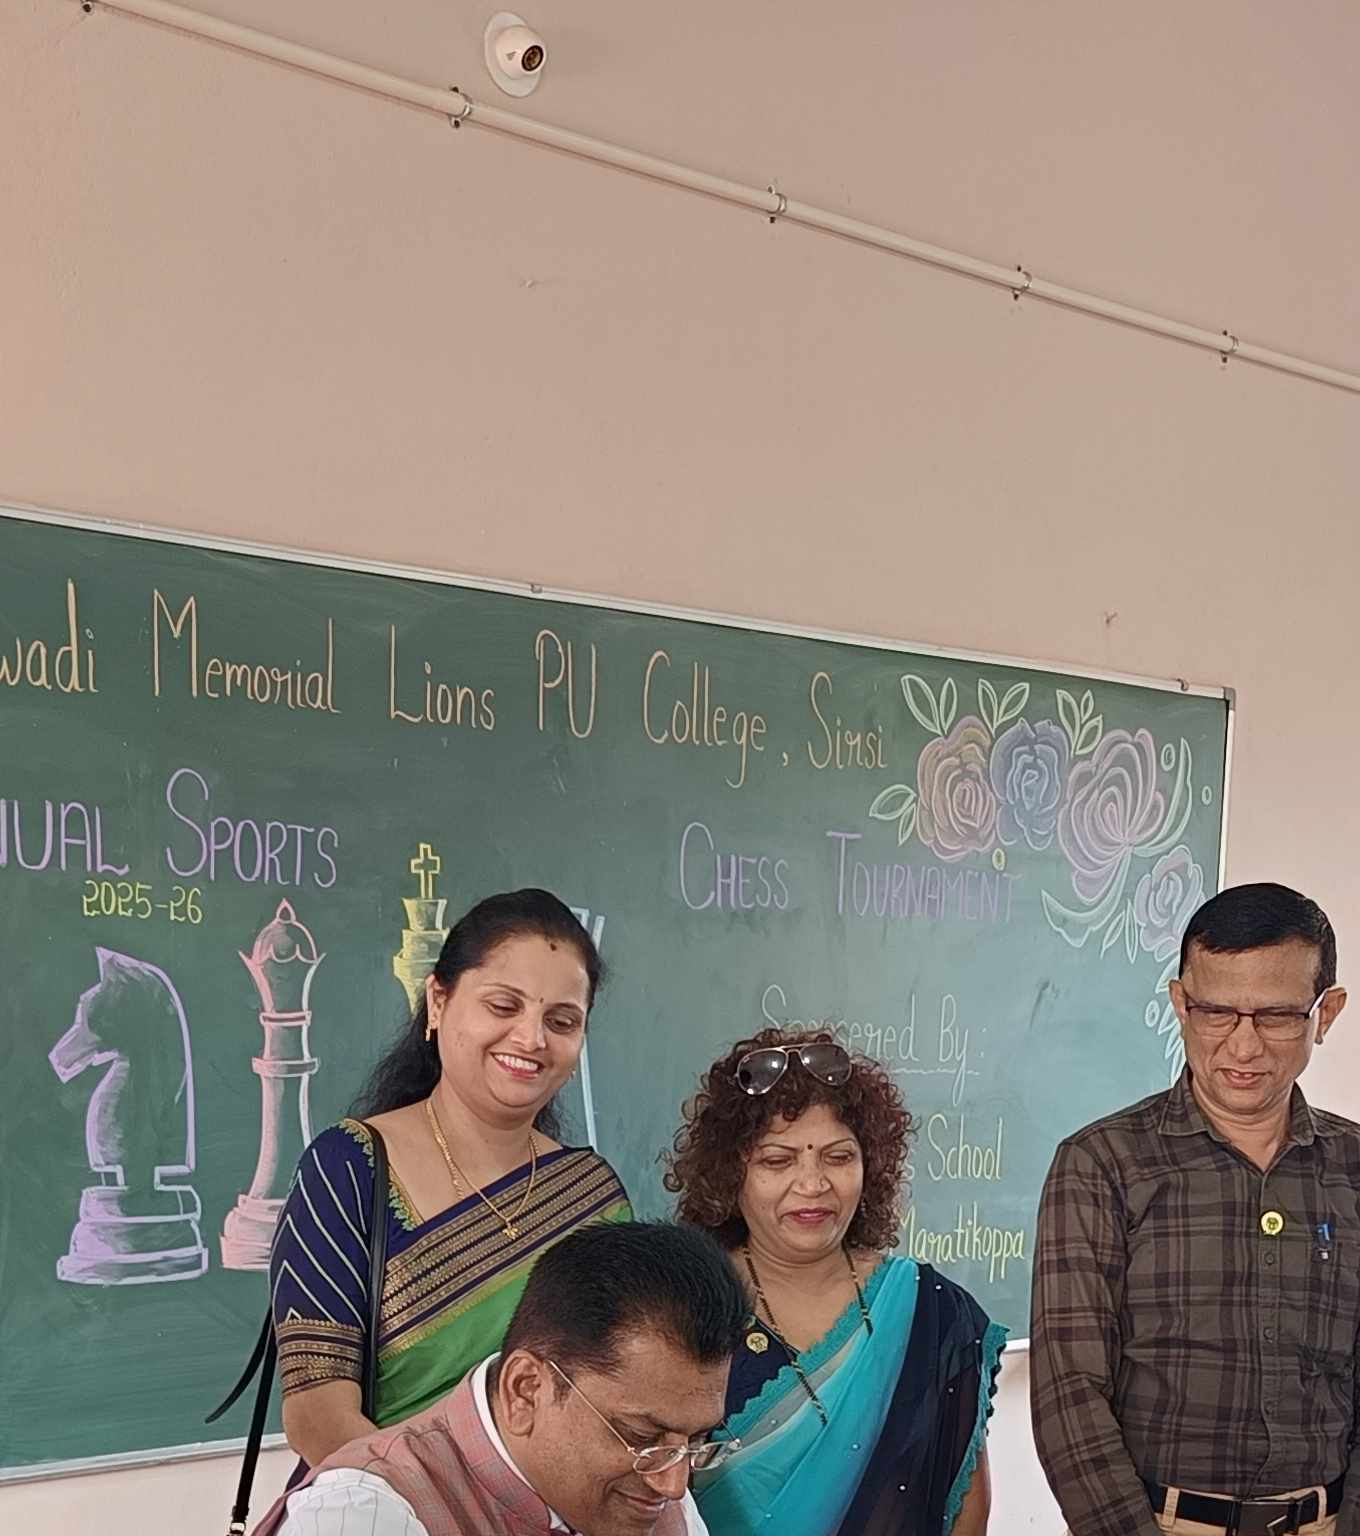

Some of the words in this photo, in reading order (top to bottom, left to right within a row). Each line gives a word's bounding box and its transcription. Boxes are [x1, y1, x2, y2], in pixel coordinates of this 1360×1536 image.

[151, 588, 342, 713] Memorial
[389, 624, 496, 730] Lions
[534, 628, 597, 739] PU
[807, 671, 889, 770] Sirsi
[165, 767, 338, 889] SPORTS
[679, 821, 790, 911] CHESS
[825, 829, 1023, 924] TOURNAMENT
[81, 879, 203, 925] 2025-26
[927, 1113, 1002, 1182] School
